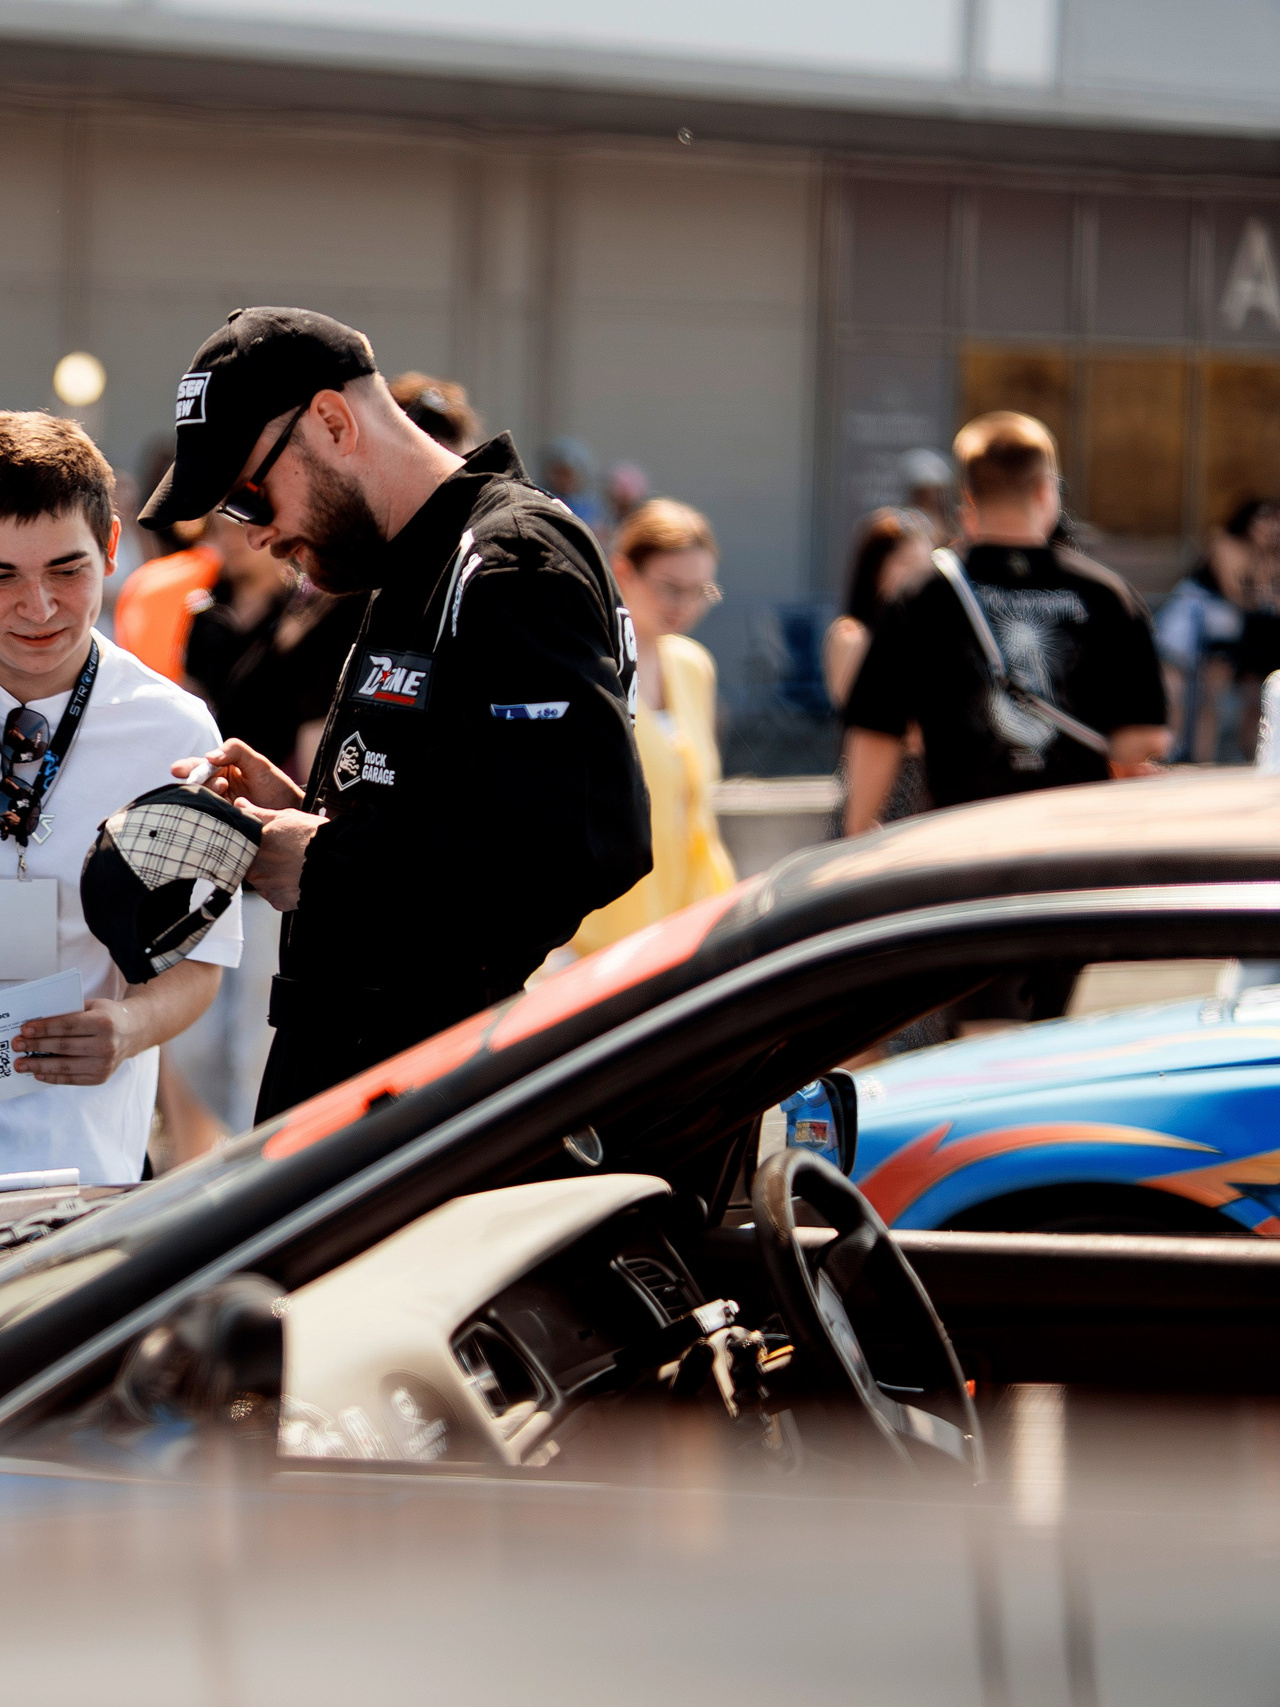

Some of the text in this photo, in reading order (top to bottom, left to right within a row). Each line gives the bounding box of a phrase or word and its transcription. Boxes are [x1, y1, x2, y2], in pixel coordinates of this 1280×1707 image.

[177, 379, 205, 400] SER
[364, 750, 387, 767] ROCK
[361, 764, 396, 786] GARAGE
